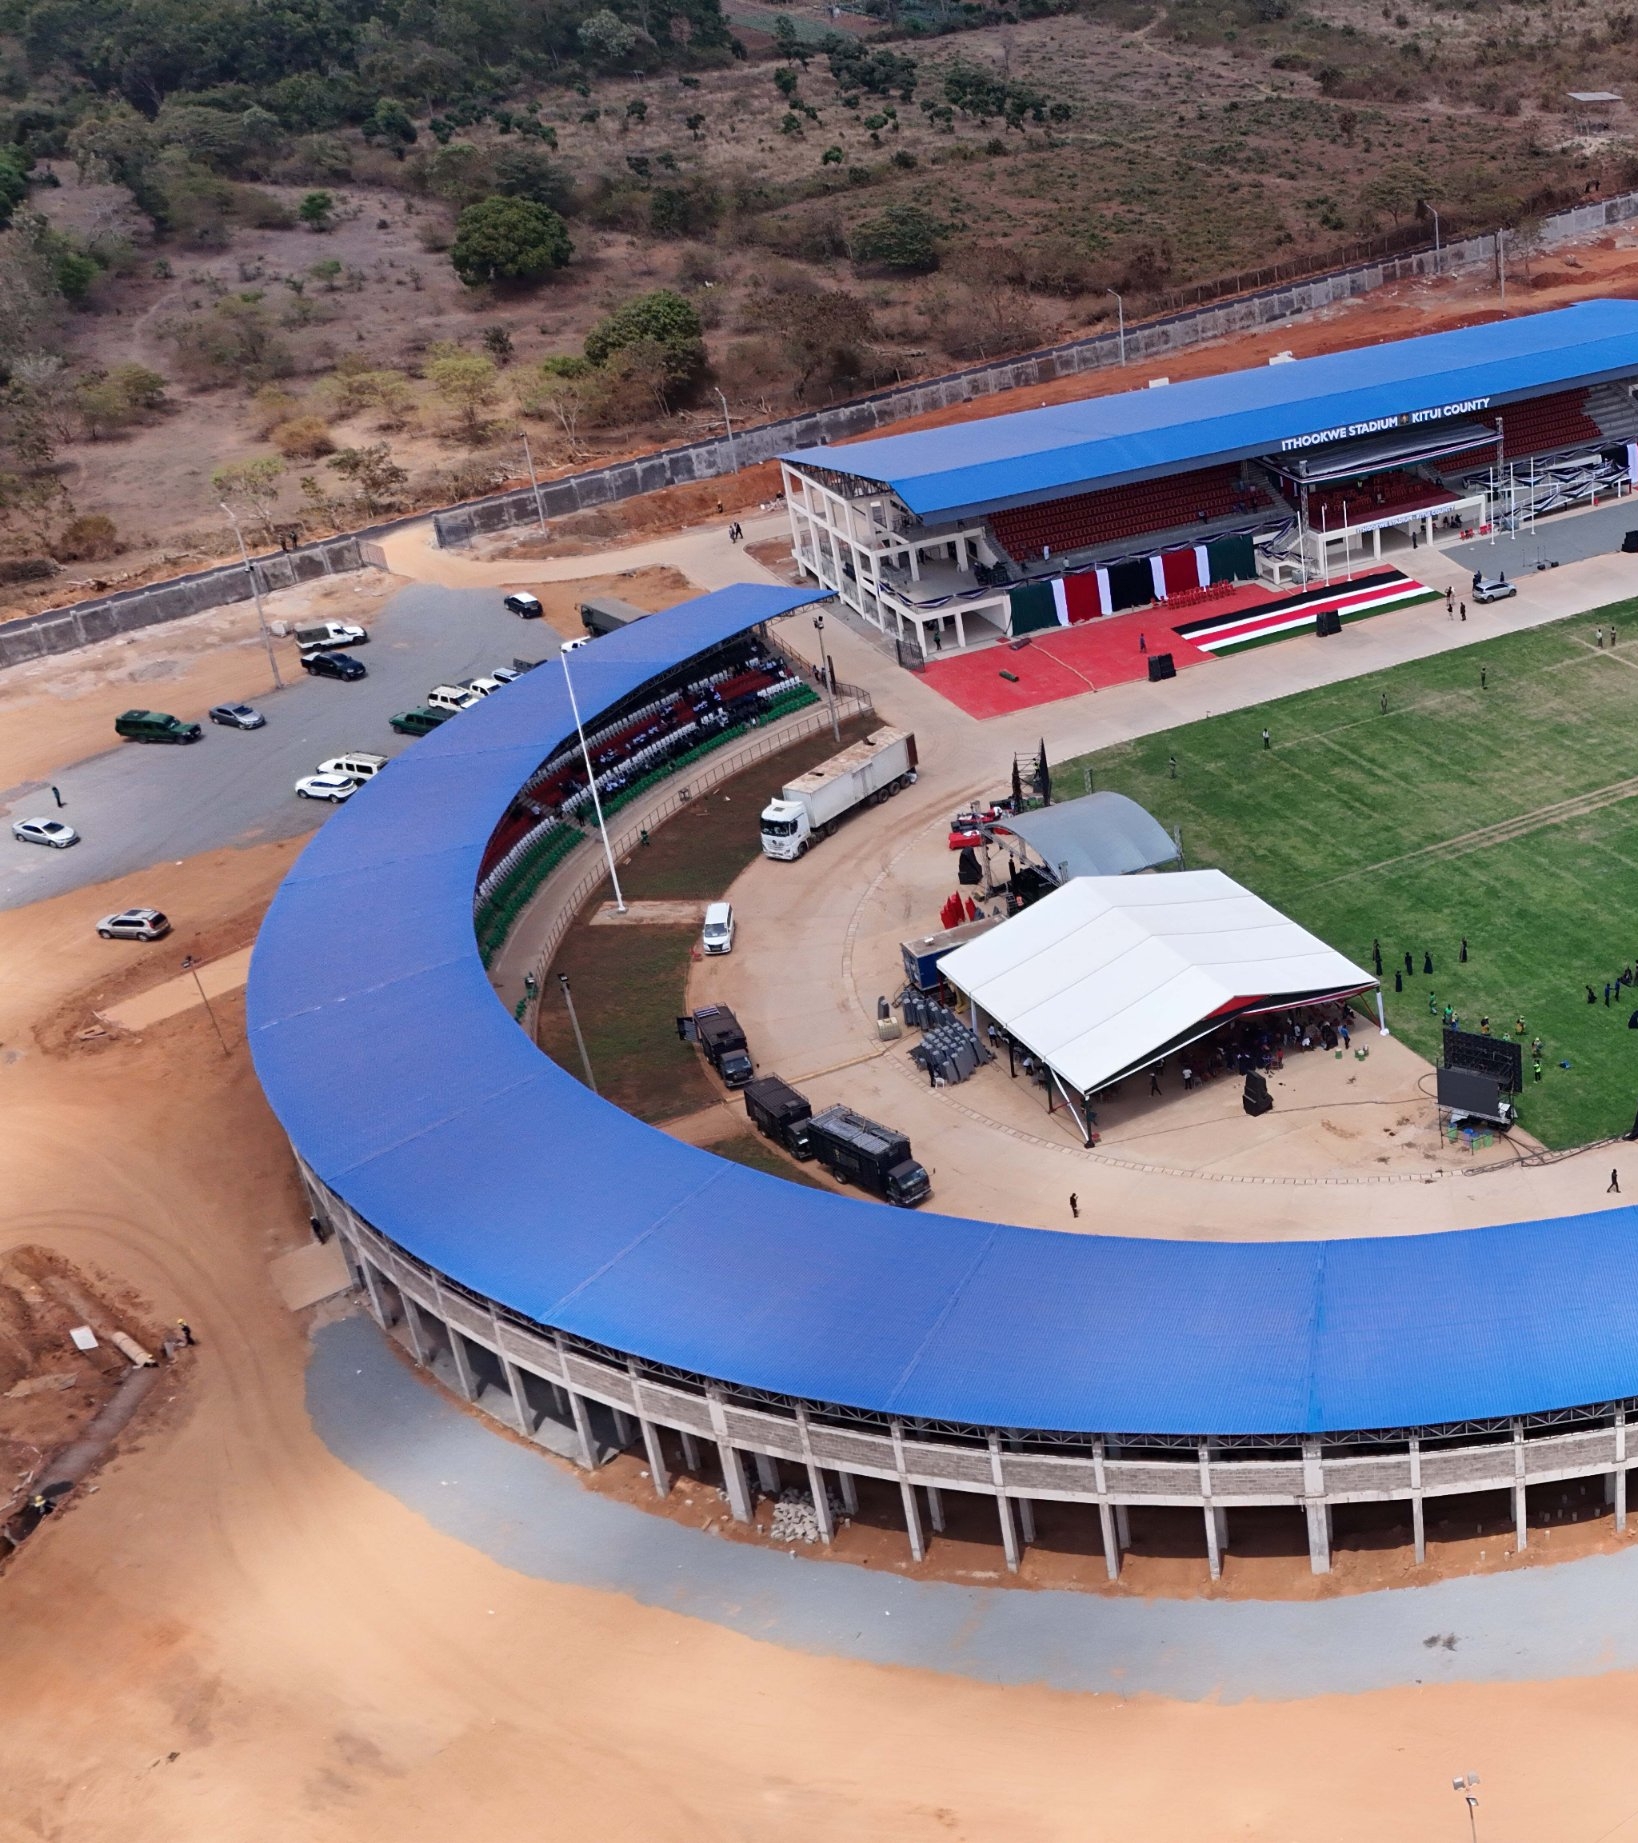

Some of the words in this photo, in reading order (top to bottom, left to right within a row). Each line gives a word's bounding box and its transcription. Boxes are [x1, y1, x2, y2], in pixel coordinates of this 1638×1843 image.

[1281, 427, 1347, 452] ITHOOKWE
[1348, 416, 1398, 436] STADIUM
[1412, 409, 1441, 424] KITUI
[1443, 397, 1490, 417] COUNTY
[1388, 516, 1412, 527] STADIUM
[1431, 505, 1455, 516] COUNTY
